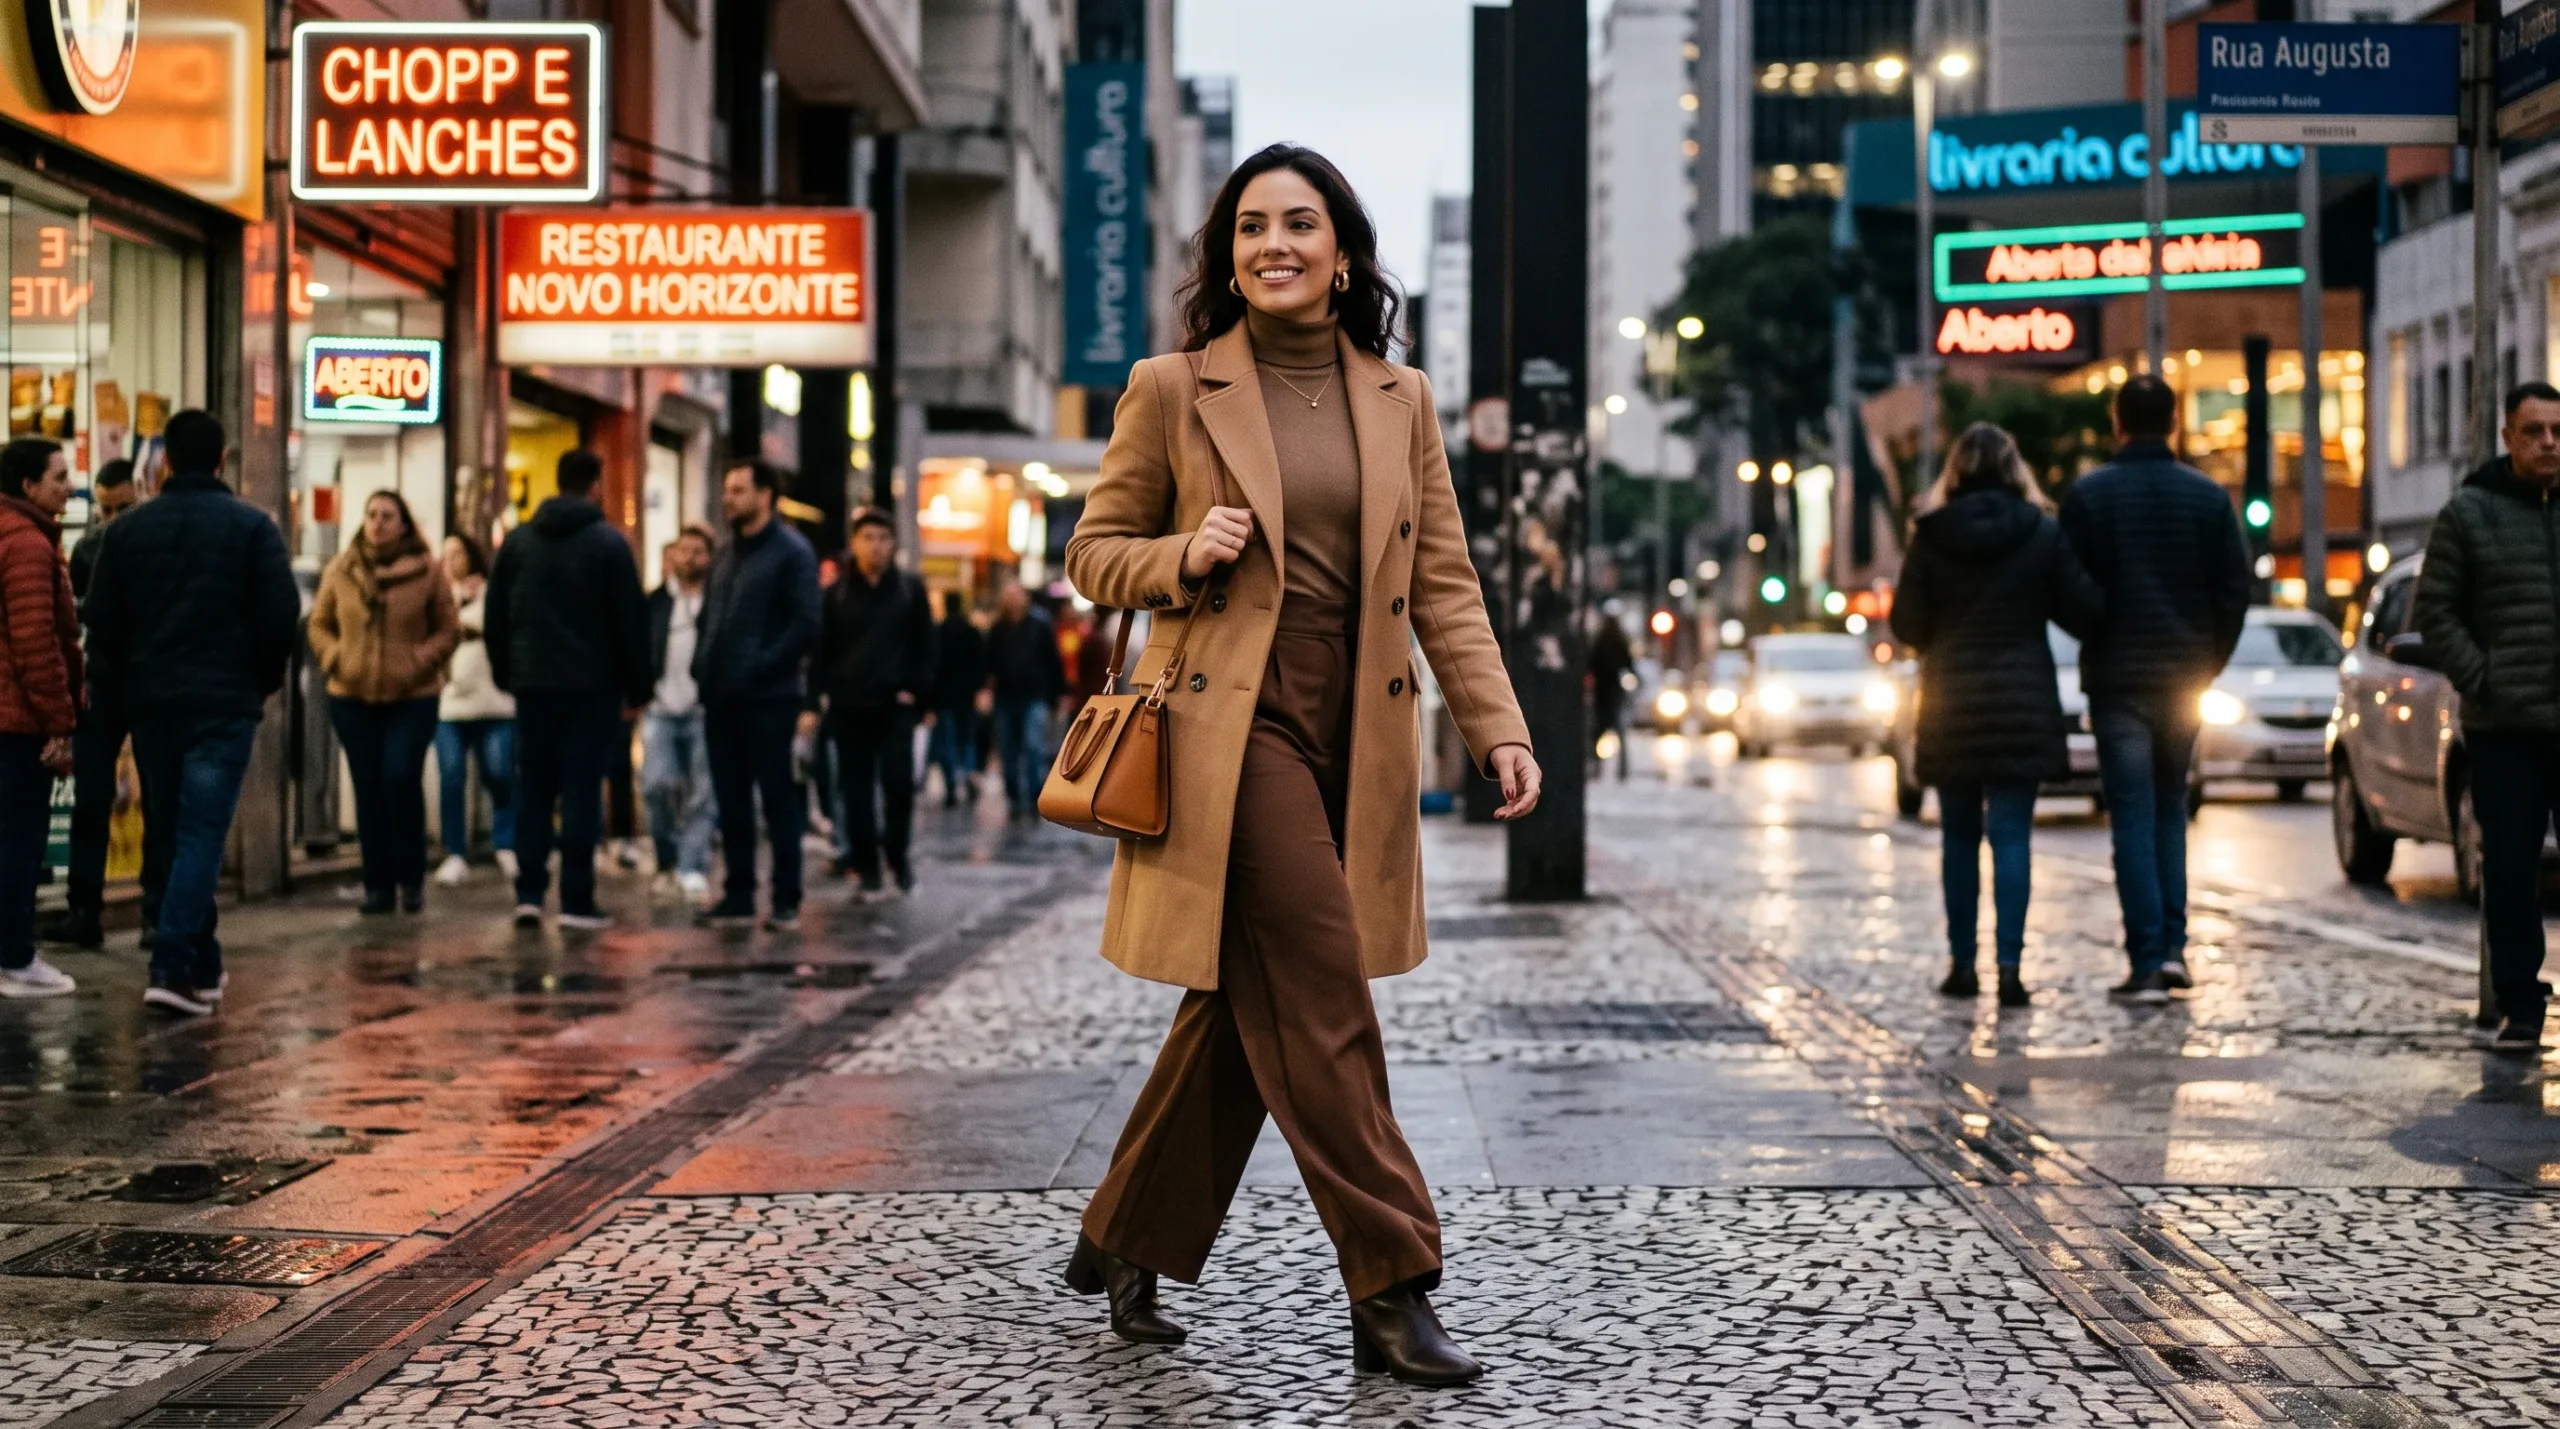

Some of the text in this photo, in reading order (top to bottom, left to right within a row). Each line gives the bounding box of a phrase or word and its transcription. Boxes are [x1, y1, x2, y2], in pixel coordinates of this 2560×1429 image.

[323, 46, 570, 104] CHOPP E
[2211, 36, 2391, 76] Rua Augusta
[316, 117, 578, 176] LANCHES
[1928, 126, 2114, 191] livraria
[540, 222, 826, 267] RESTAURANTE
[507, 272, 859, 316] NOVO HORIZONTE
[1937, 306, 2074, 354] Aberto
[315, 356, 430, 399] ABERTO
